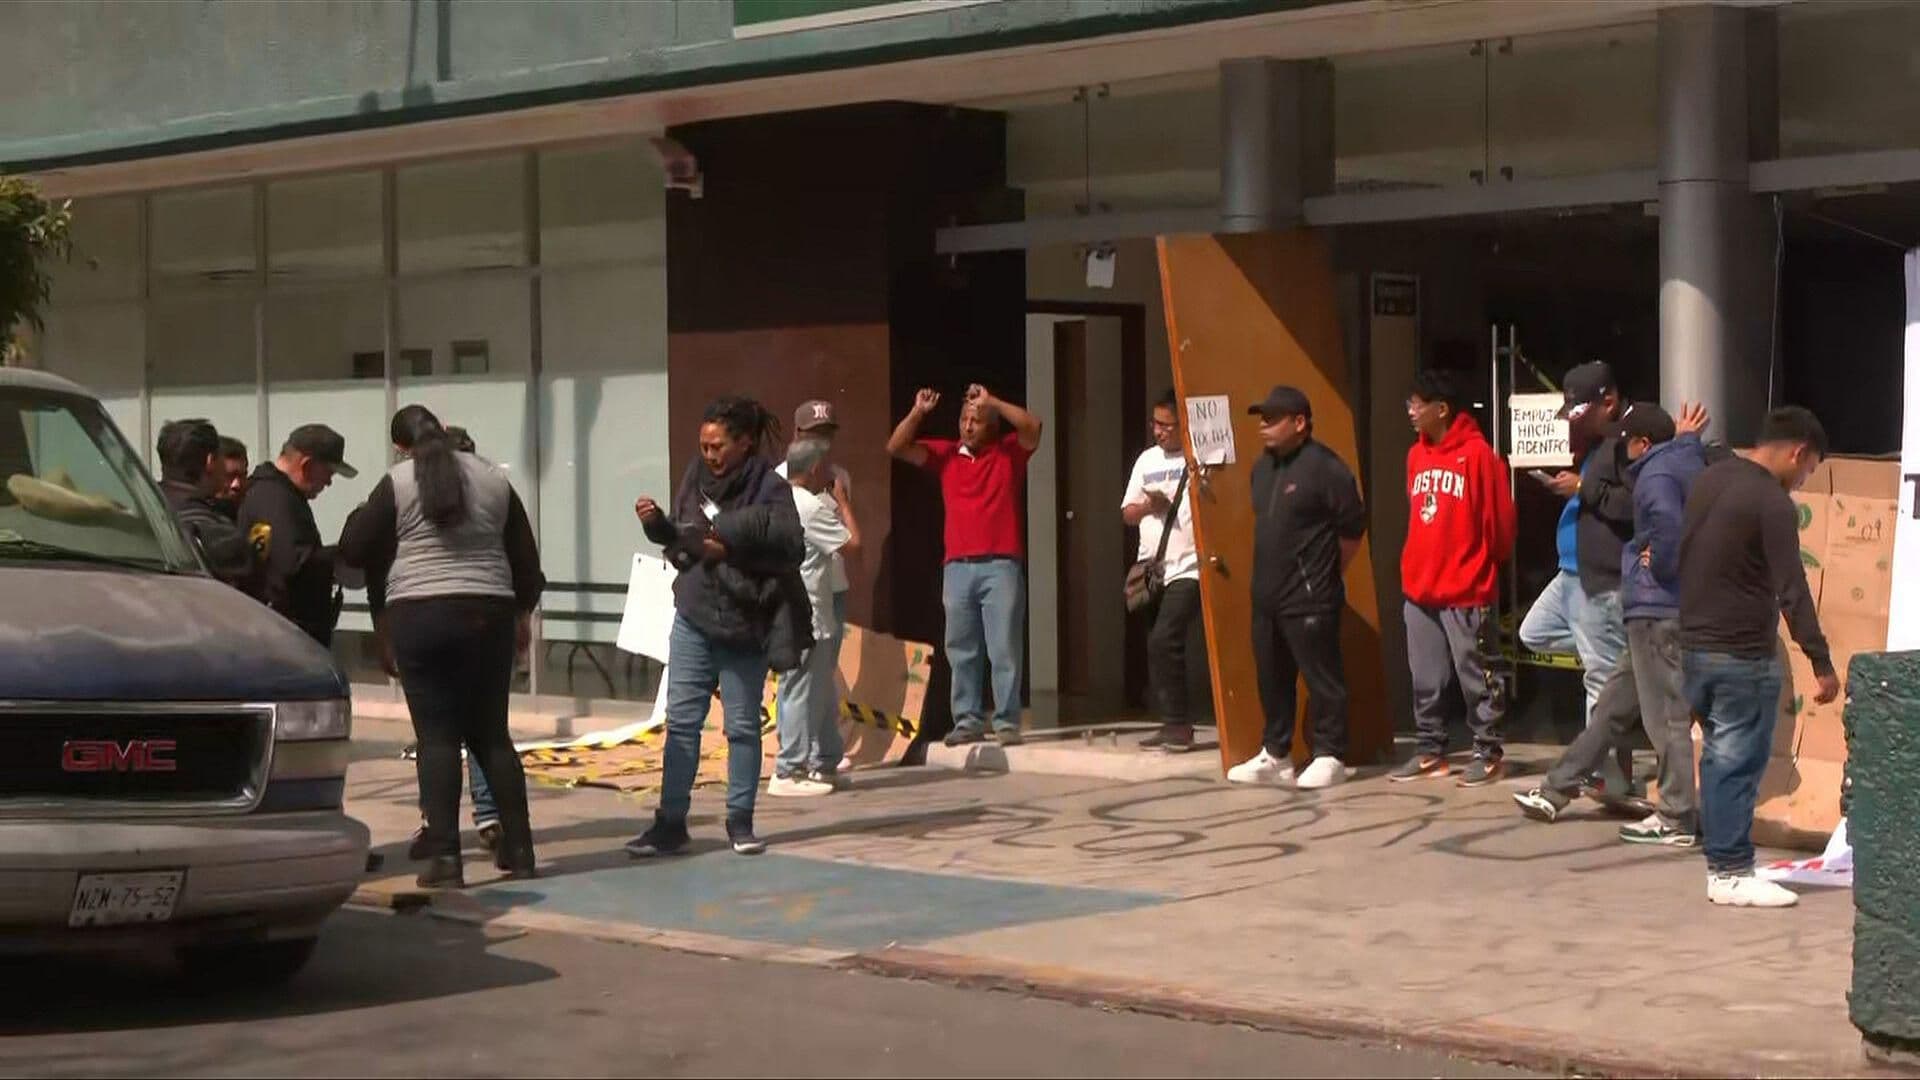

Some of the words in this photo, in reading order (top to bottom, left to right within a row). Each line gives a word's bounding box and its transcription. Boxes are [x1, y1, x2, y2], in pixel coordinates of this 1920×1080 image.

[1195, 399, 1217, 420] NO
[1517, 422, 1555, 438] HACIA
[1410, 468, 1465, 499] OSTON
[62, 740, 177, 772] GMC
